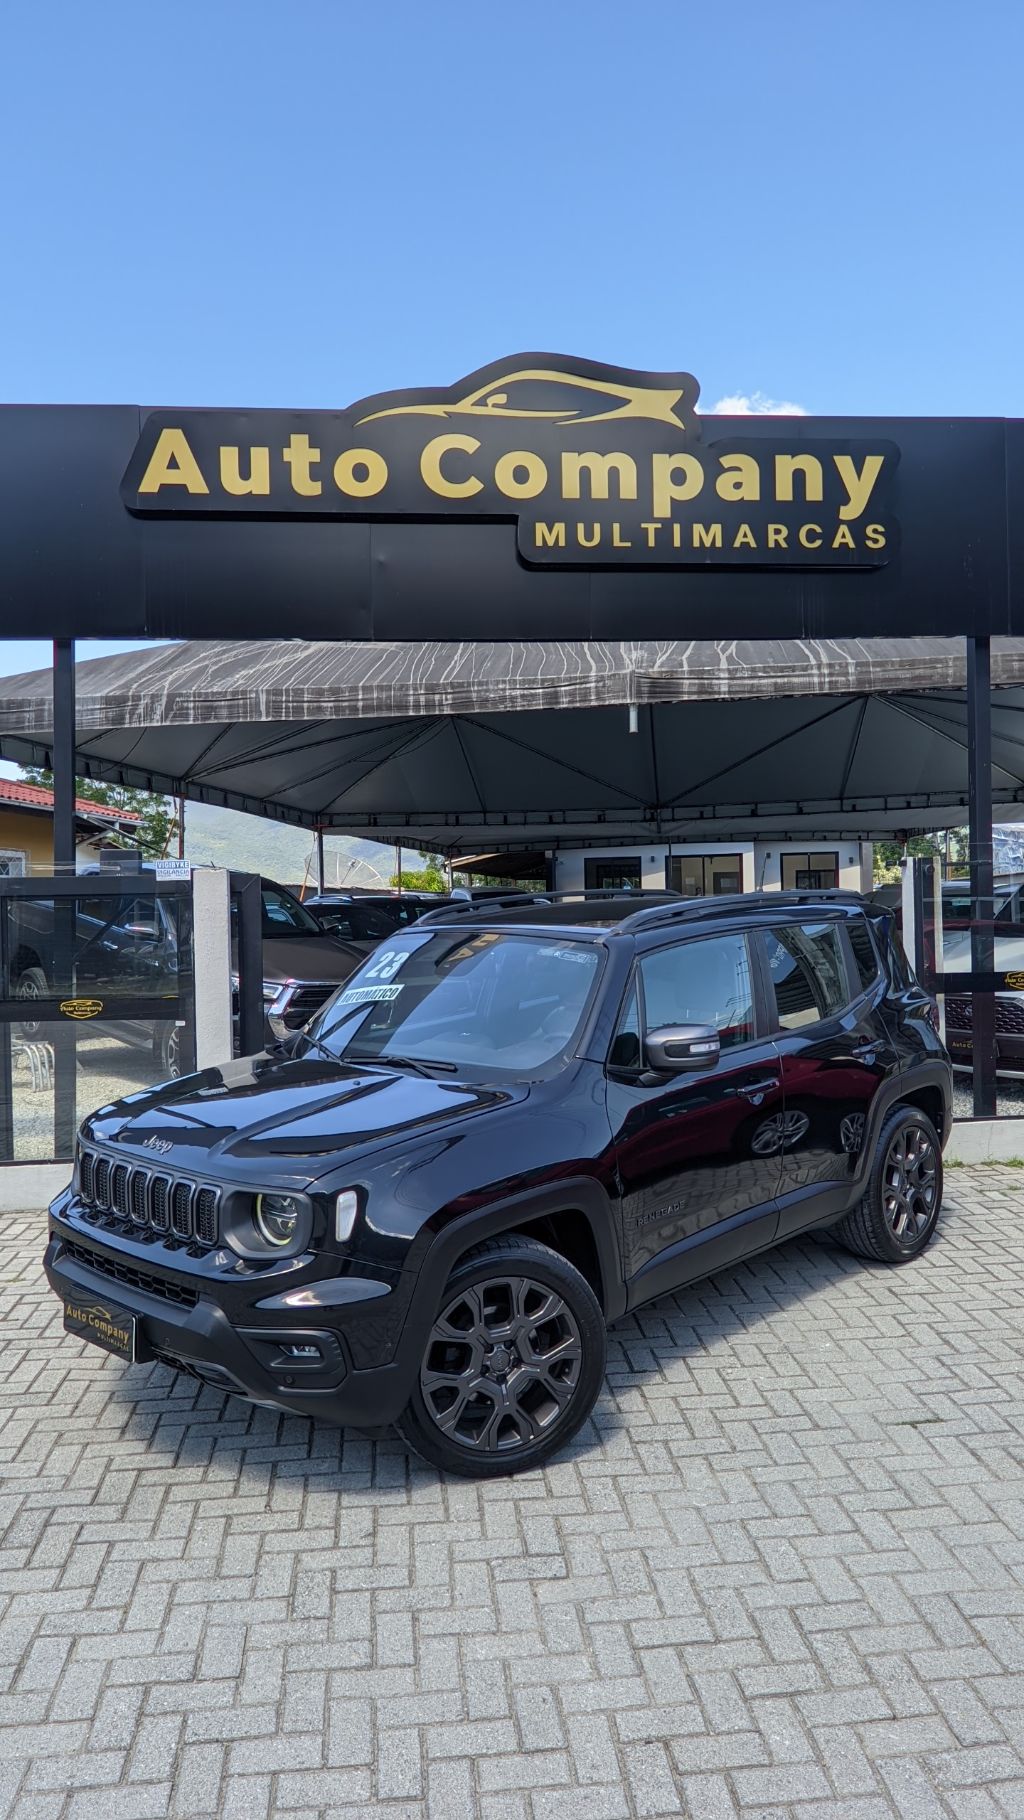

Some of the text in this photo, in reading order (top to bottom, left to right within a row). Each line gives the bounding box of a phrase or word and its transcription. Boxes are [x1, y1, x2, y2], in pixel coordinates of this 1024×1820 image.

[140, 429, 883, 521] Auto Company
[534, 522, 886, 549] MULTIMARCAS
[365, 951, 410, 979] 23
[143, 1134, 173, 1155] Jeep
[66, 1304, 129, 1344] Auto Company
